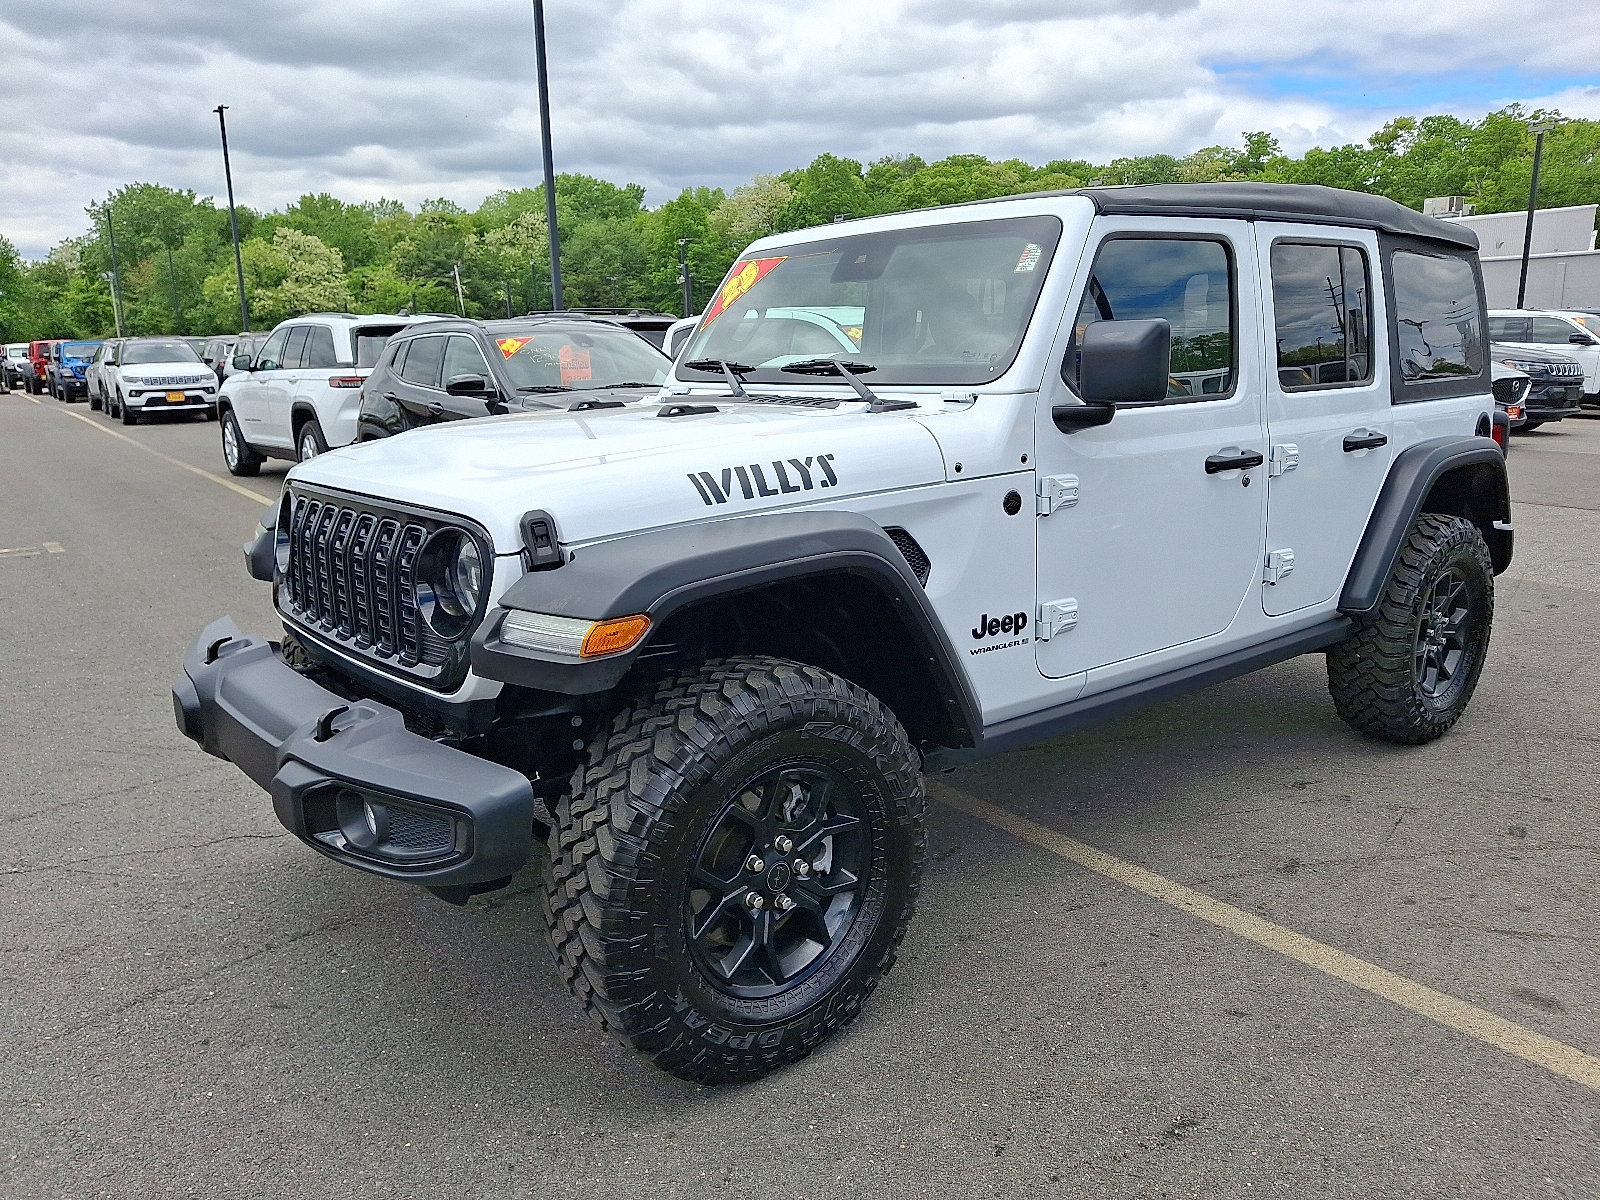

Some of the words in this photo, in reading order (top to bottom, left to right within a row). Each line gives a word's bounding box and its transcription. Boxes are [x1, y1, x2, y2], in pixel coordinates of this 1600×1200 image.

[686, 453, 838, 506] WILLYS
[971, 611, 1028, 640] Jeep
[969, 640, 1020, 656] WRANGLER
